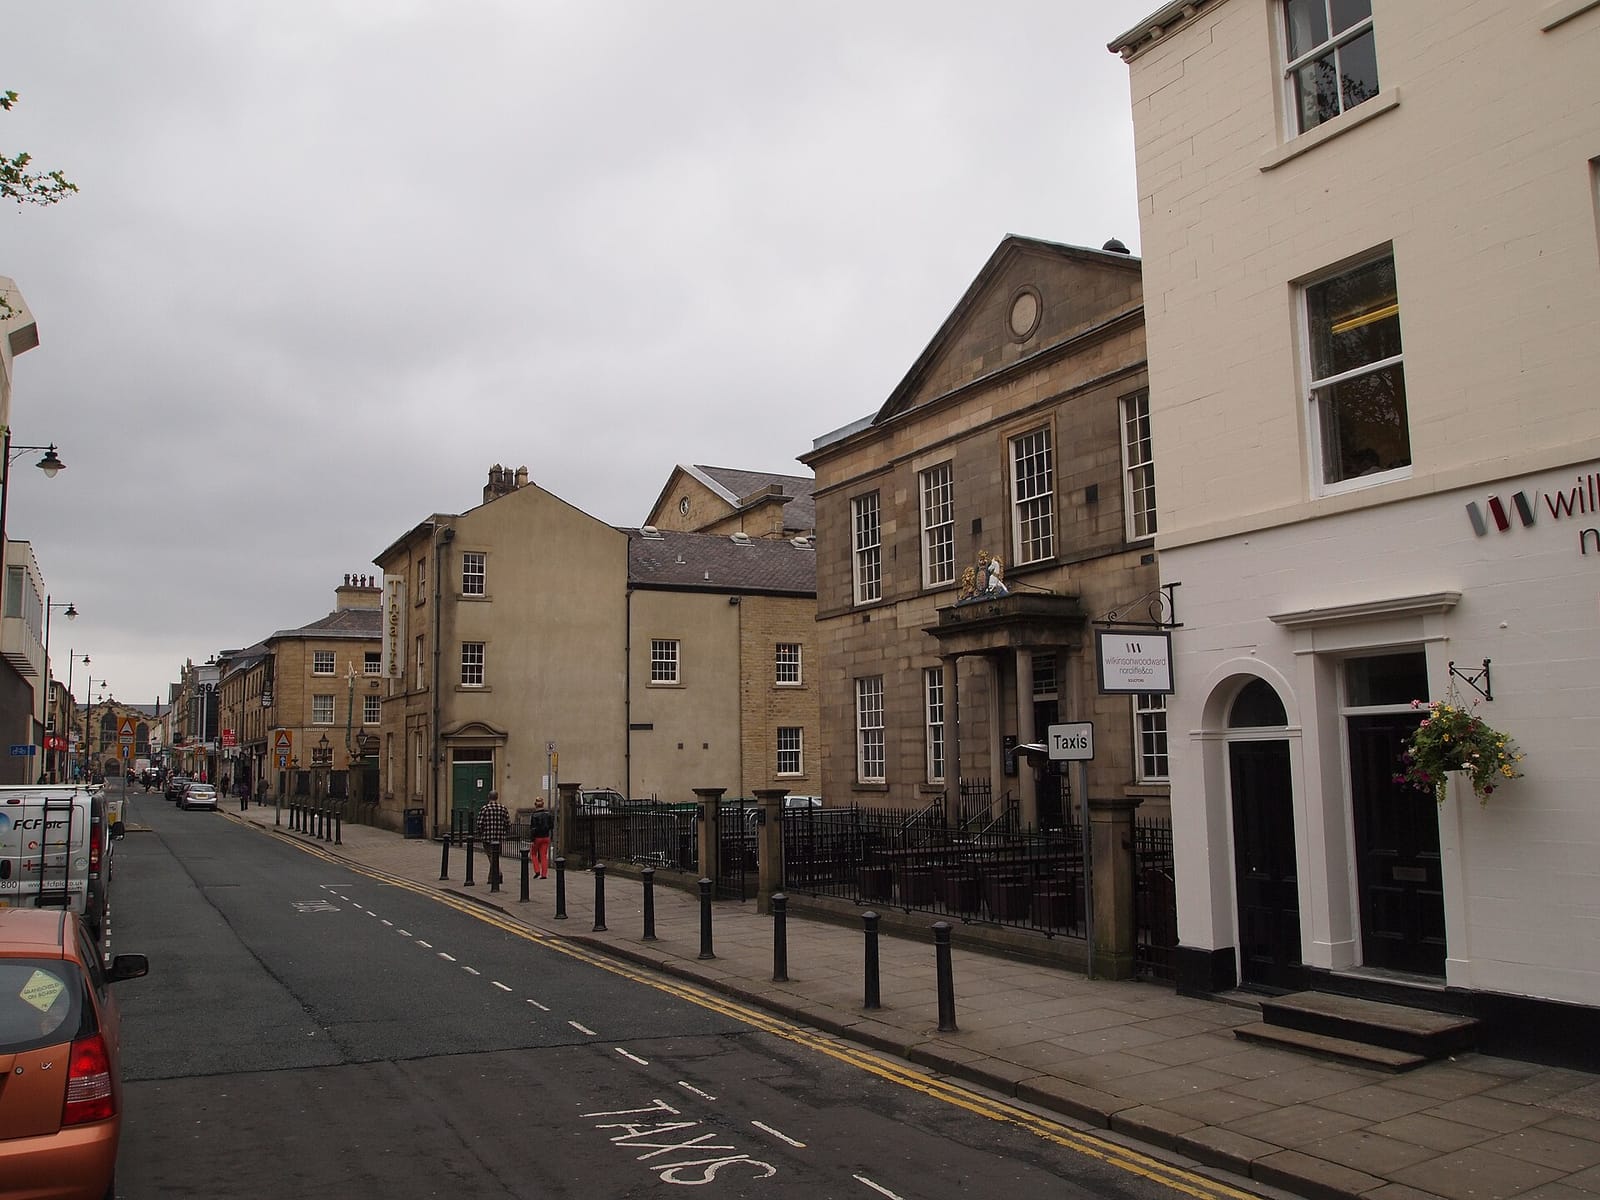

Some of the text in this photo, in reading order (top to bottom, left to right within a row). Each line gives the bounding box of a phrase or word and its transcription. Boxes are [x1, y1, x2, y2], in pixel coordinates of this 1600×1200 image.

[388, 580, 401, 675] Theatre
[1053, 733, 1088, 750] Taxis
[13, 818, 43, 831] FCF
[579, 1099, 777, 1185] TAXIS
